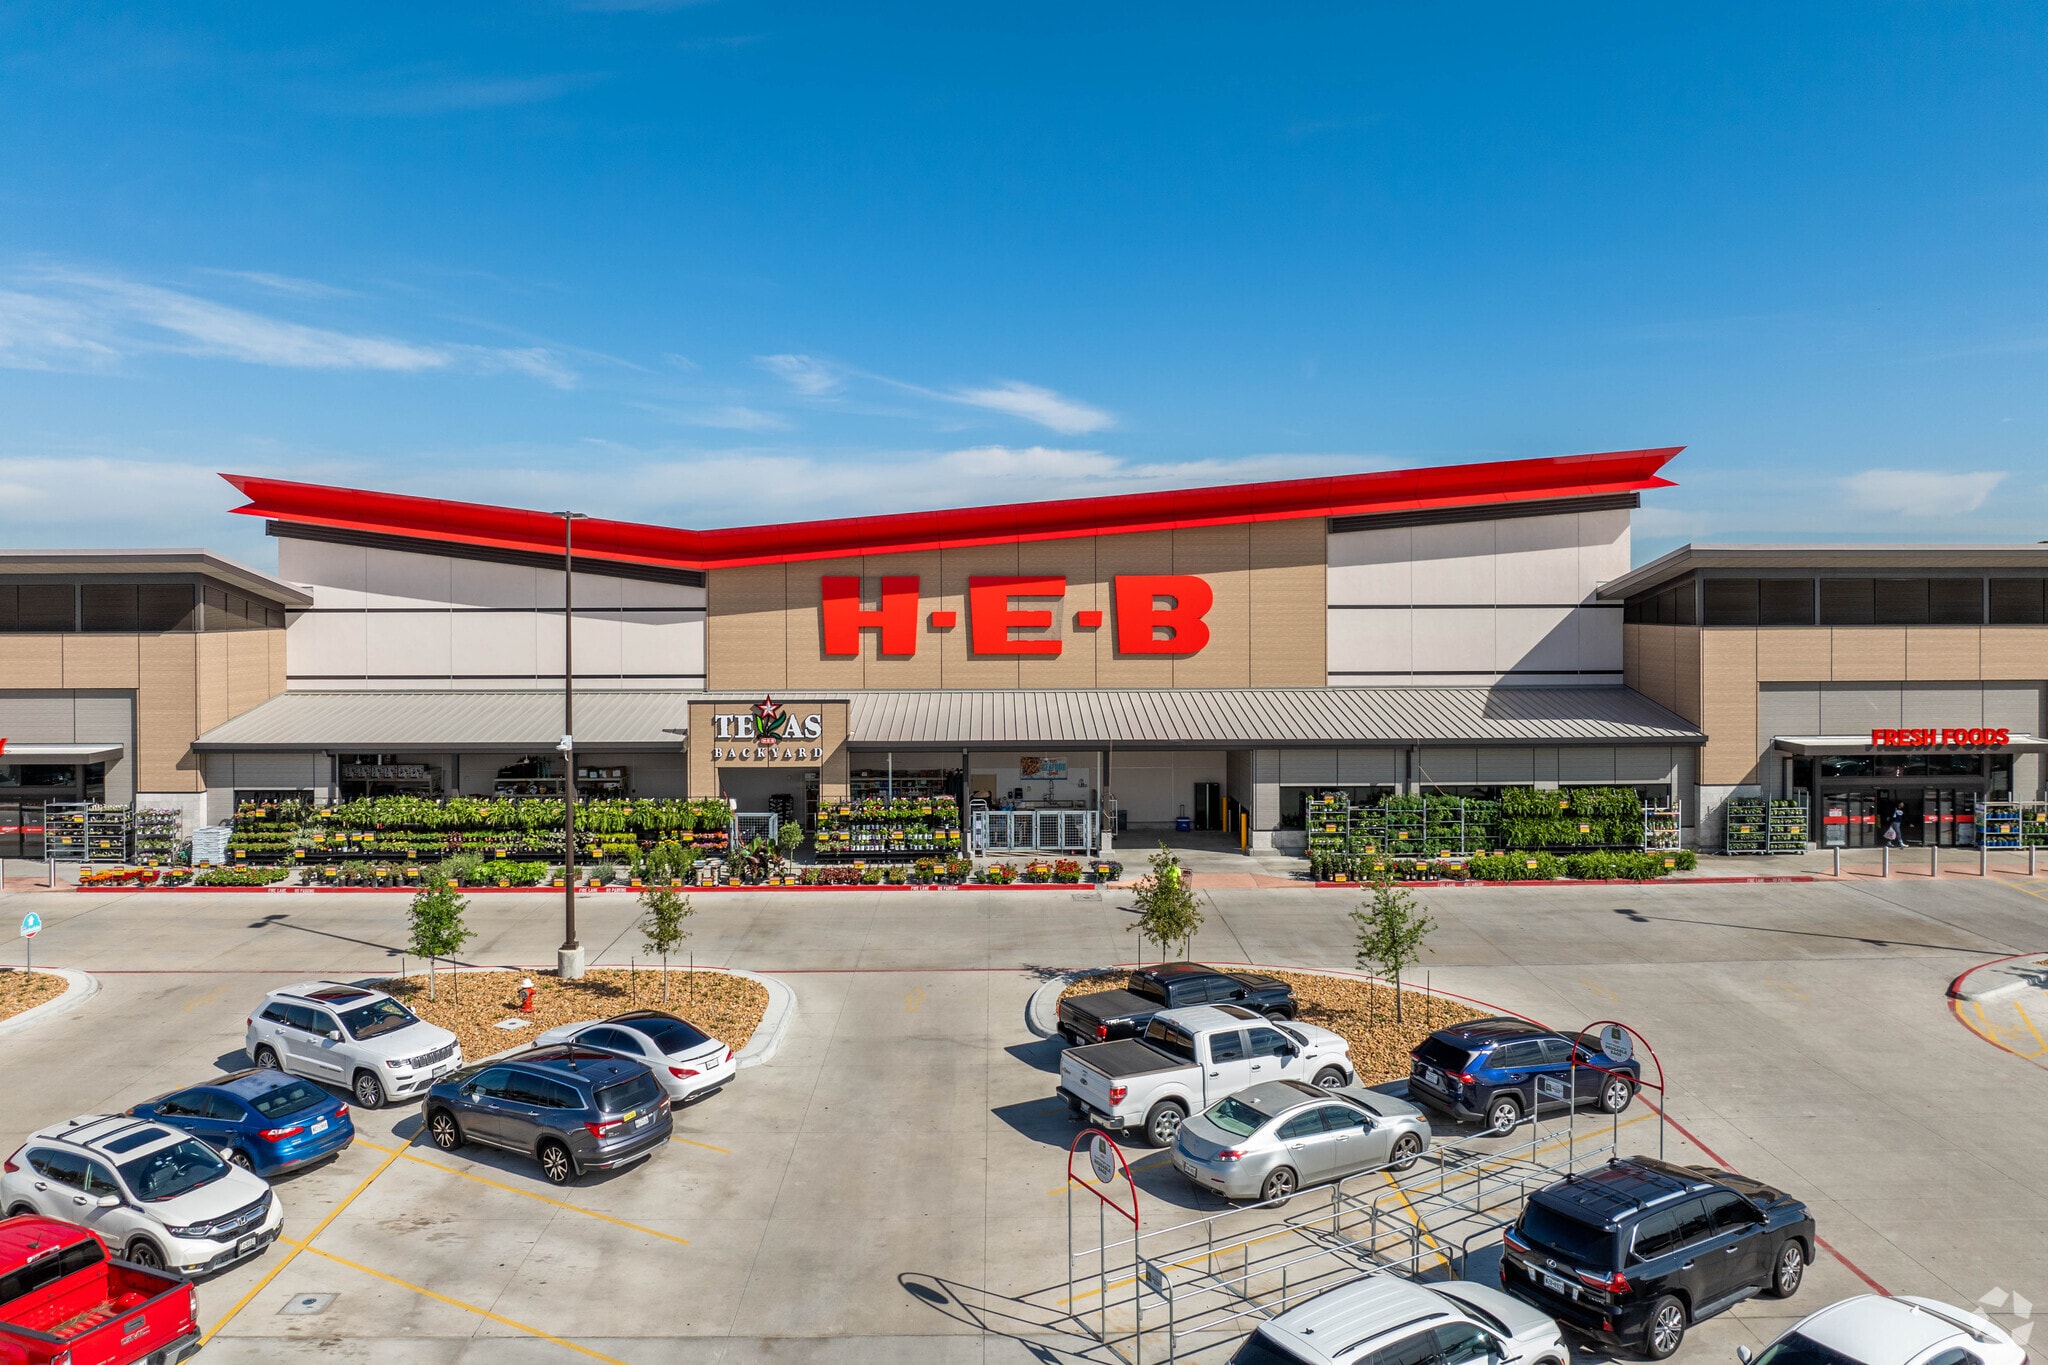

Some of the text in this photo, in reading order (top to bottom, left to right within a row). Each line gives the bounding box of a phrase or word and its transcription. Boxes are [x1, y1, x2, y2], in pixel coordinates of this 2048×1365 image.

[821, 575, 1214, 655] H-E-B
[714, 713, 822, 739] TEXAS
[1872, 727, 2010, 747] FRESH FOODS
[714, 747, 823, 758] BACKYARD
